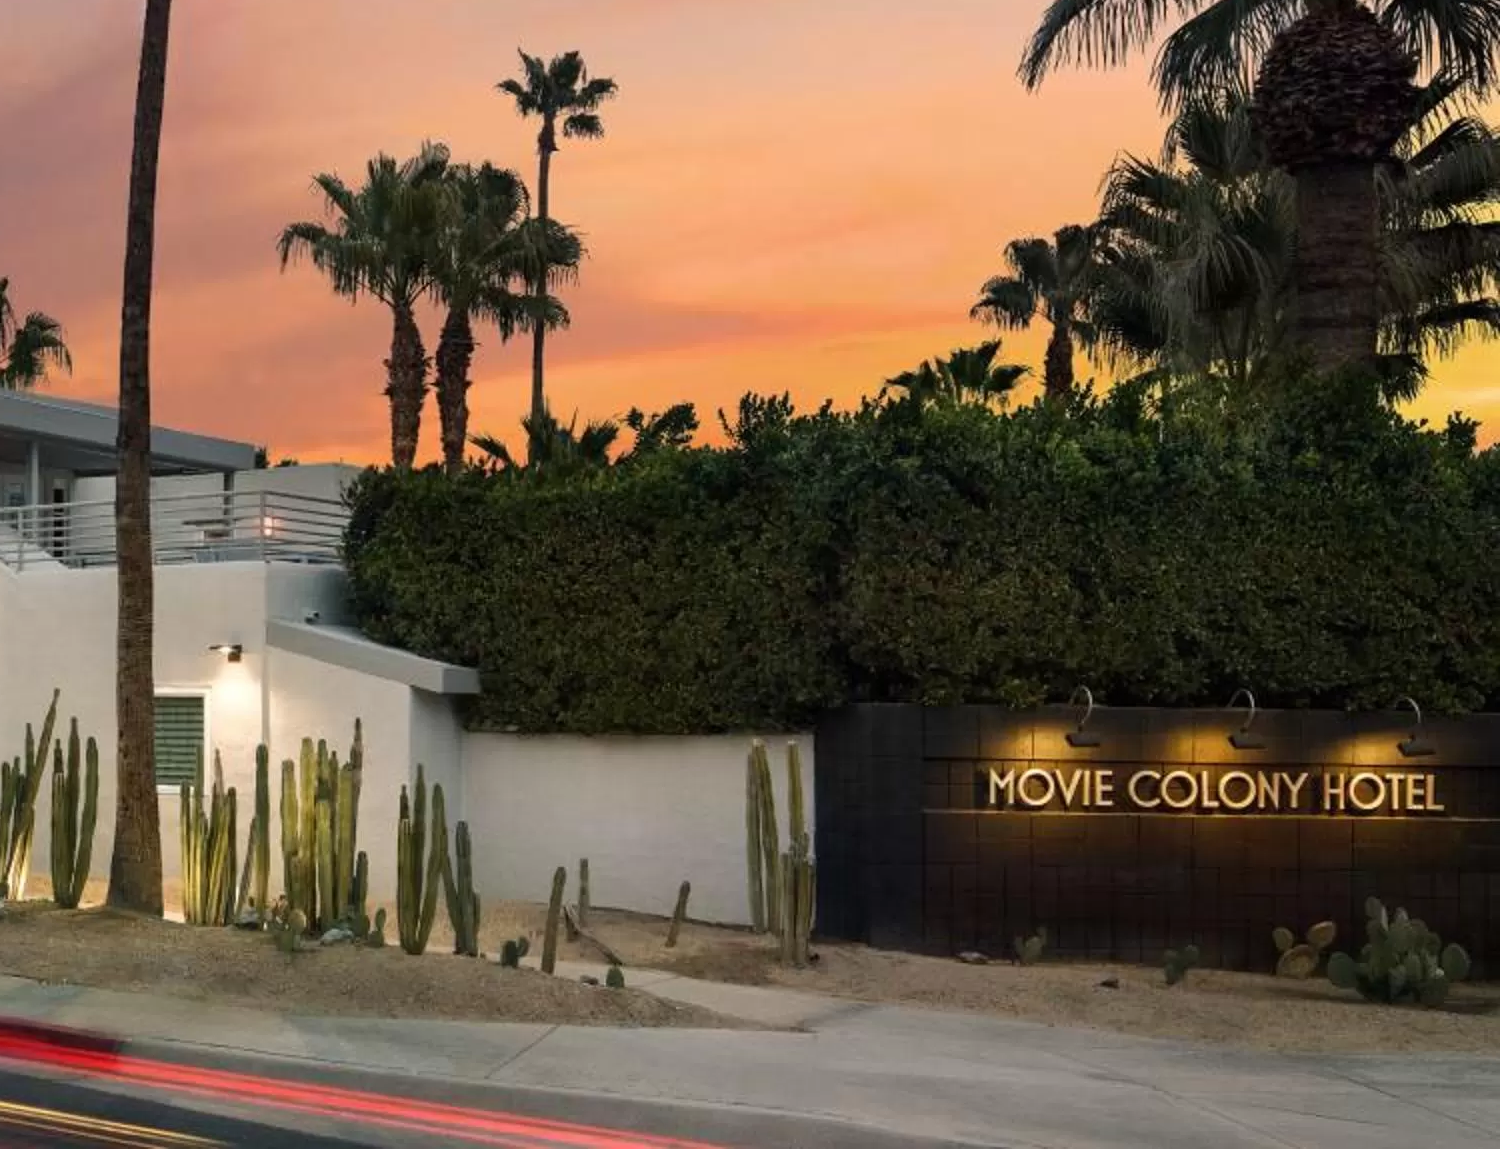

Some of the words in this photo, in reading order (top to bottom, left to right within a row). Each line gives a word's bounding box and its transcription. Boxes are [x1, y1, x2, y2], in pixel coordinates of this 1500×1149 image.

[989, 767, 1114, 806] MOVIE
[1128, 769, 1309, 809] COLONY
[1324, 772, 1445, 811] HOTEL
